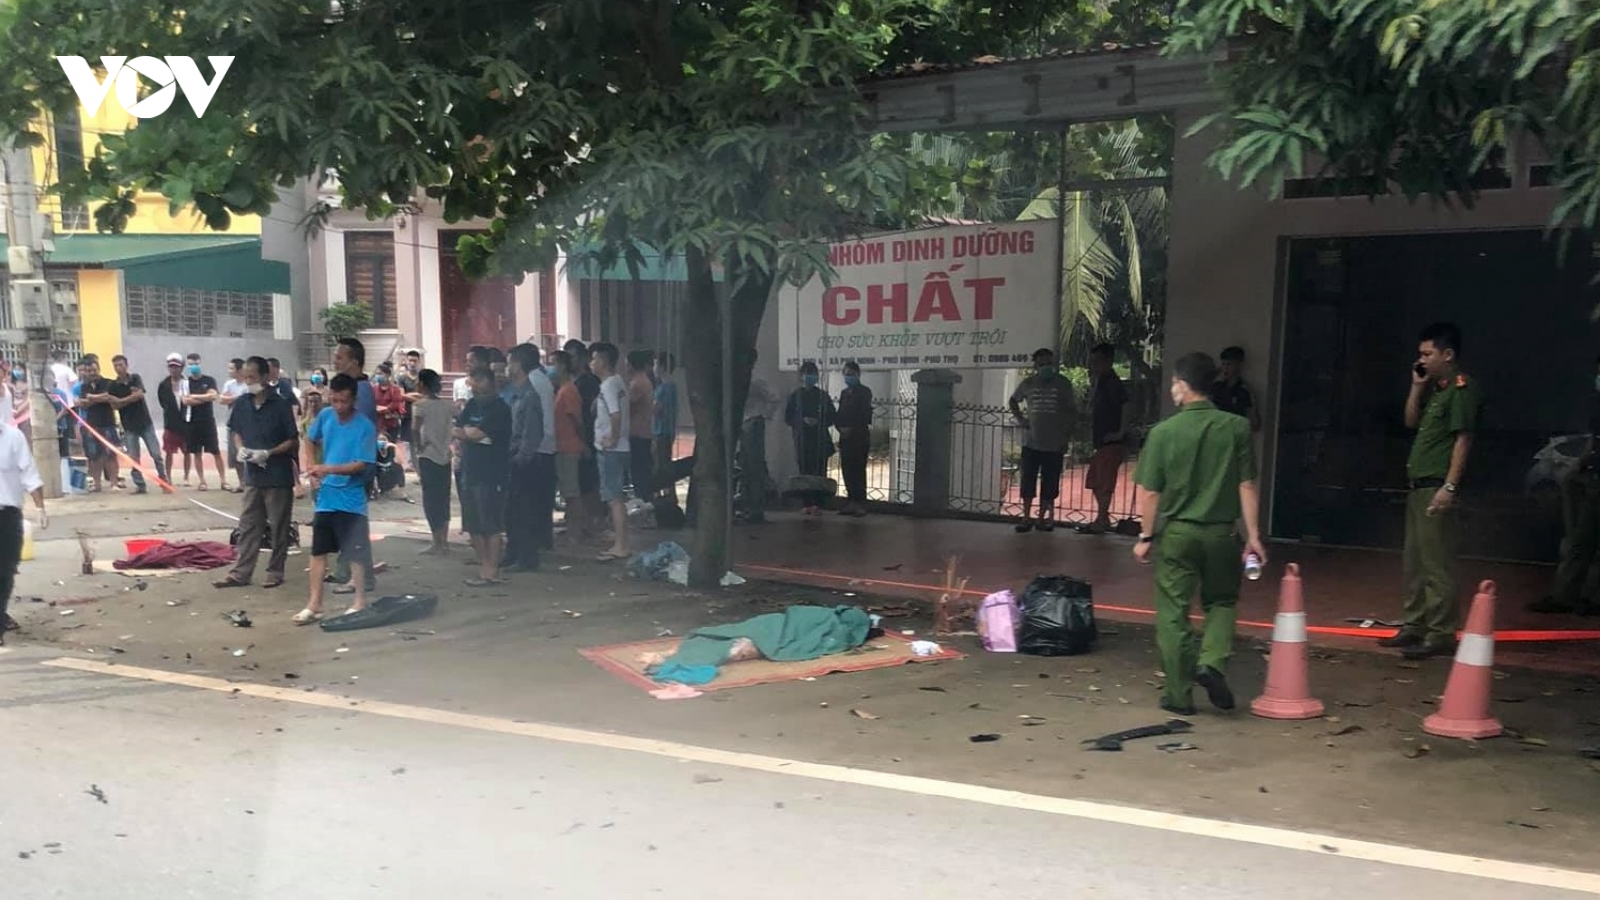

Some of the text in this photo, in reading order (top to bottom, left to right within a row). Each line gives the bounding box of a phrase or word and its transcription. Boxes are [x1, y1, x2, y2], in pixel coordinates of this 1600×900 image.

[892, 238, 945, 262] DINH
[953, 227, 1034, 259] DƯỠNG
[822, 264, 1006, 326] CHẤT
[816, 336, 844, 349] CHO
[969, 328, 1008, 347] TRỘI
